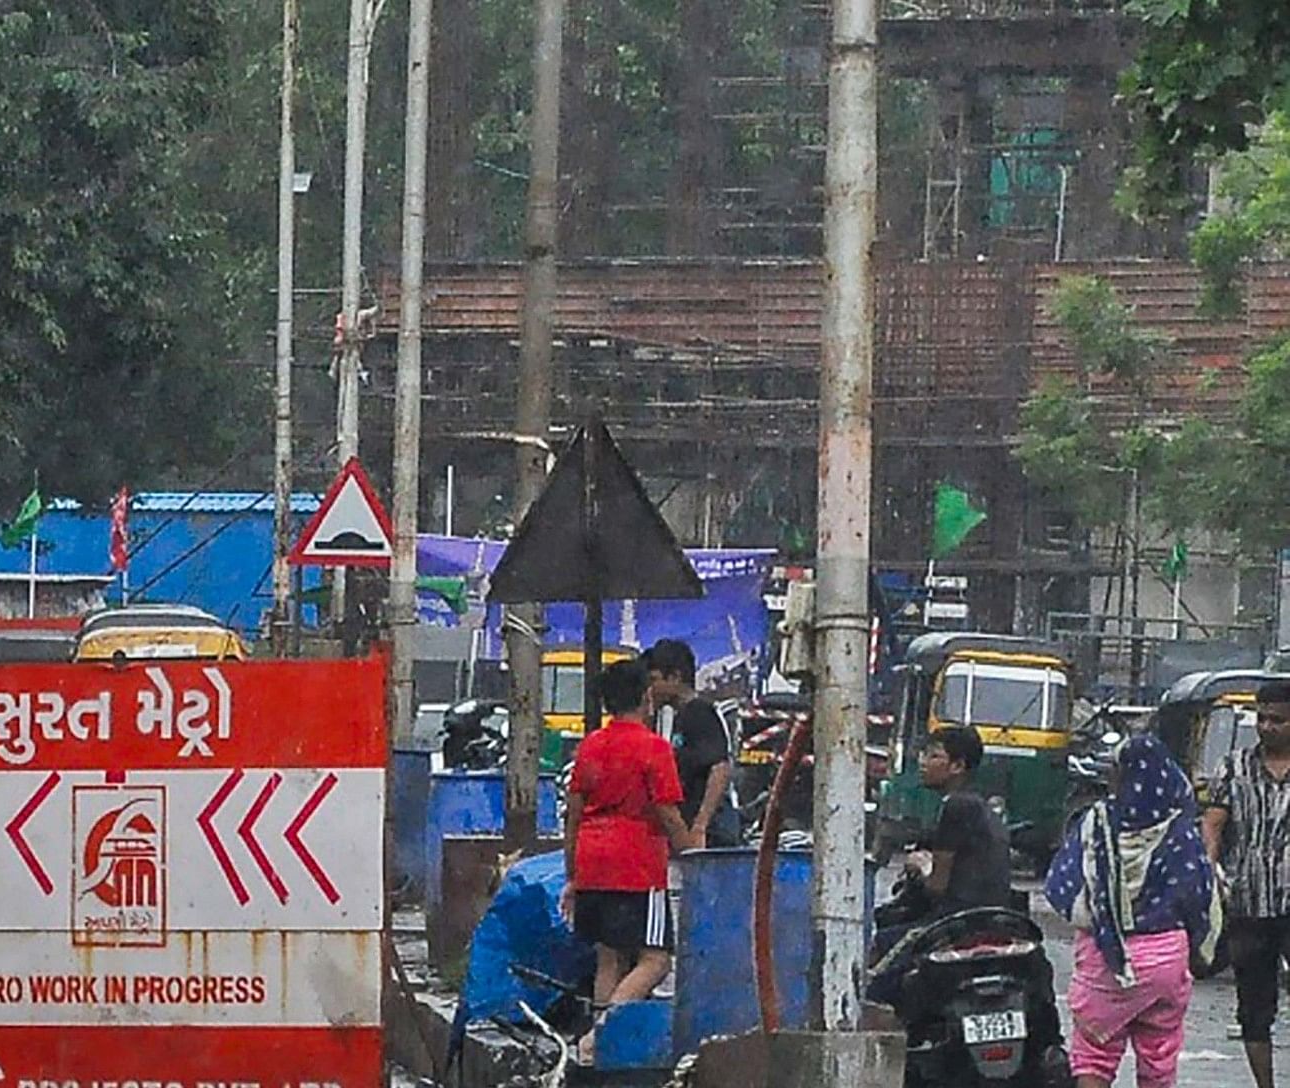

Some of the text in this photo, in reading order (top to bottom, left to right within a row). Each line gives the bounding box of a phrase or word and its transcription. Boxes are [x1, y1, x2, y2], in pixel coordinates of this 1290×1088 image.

[136, 667, 231, 757] મેટ્રો
[29, 976, 97, 1003] WORK
[104, 976, 126, 1003] IN
[133, 976, 266, 1004] PROGRESS
